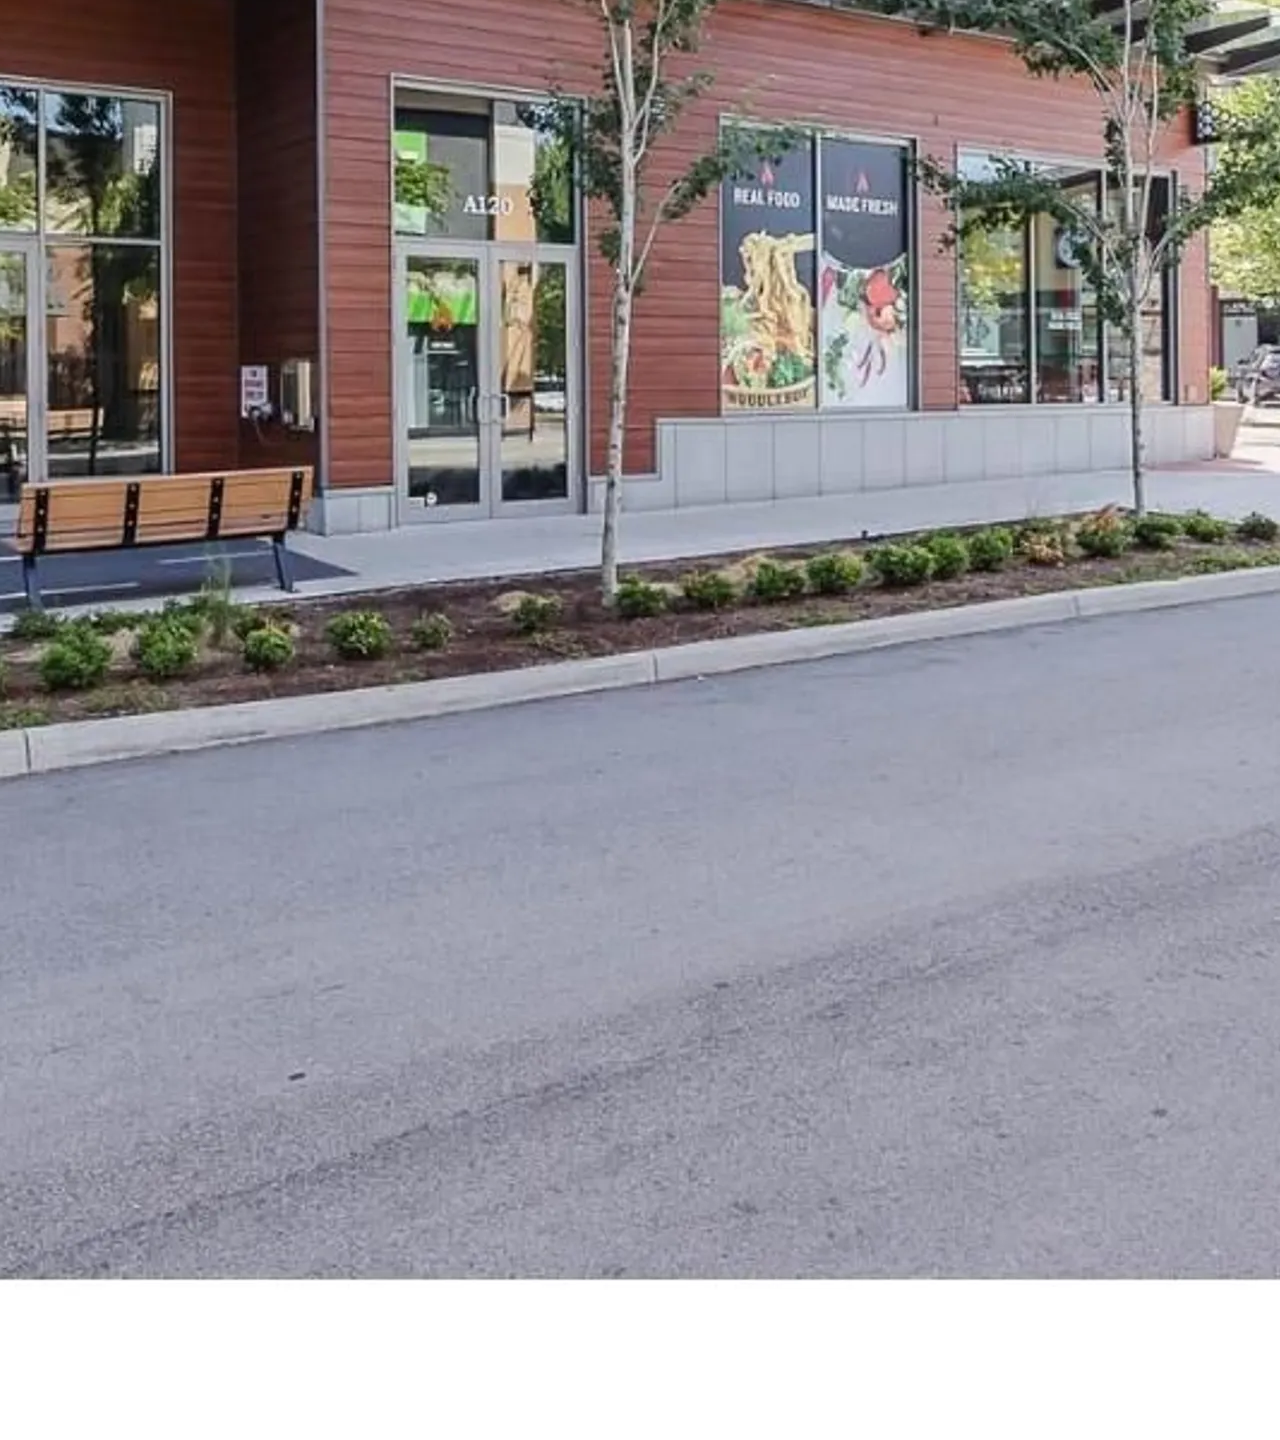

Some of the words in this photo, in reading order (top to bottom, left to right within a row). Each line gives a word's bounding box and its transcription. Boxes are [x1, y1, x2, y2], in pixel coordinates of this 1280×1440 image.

[733, 187, 766, 206] REAL
[767, 191, 801, 209] FOOD
[826, 194, 860, 213] MADE
[861, 198, 899, 216] FRESH
